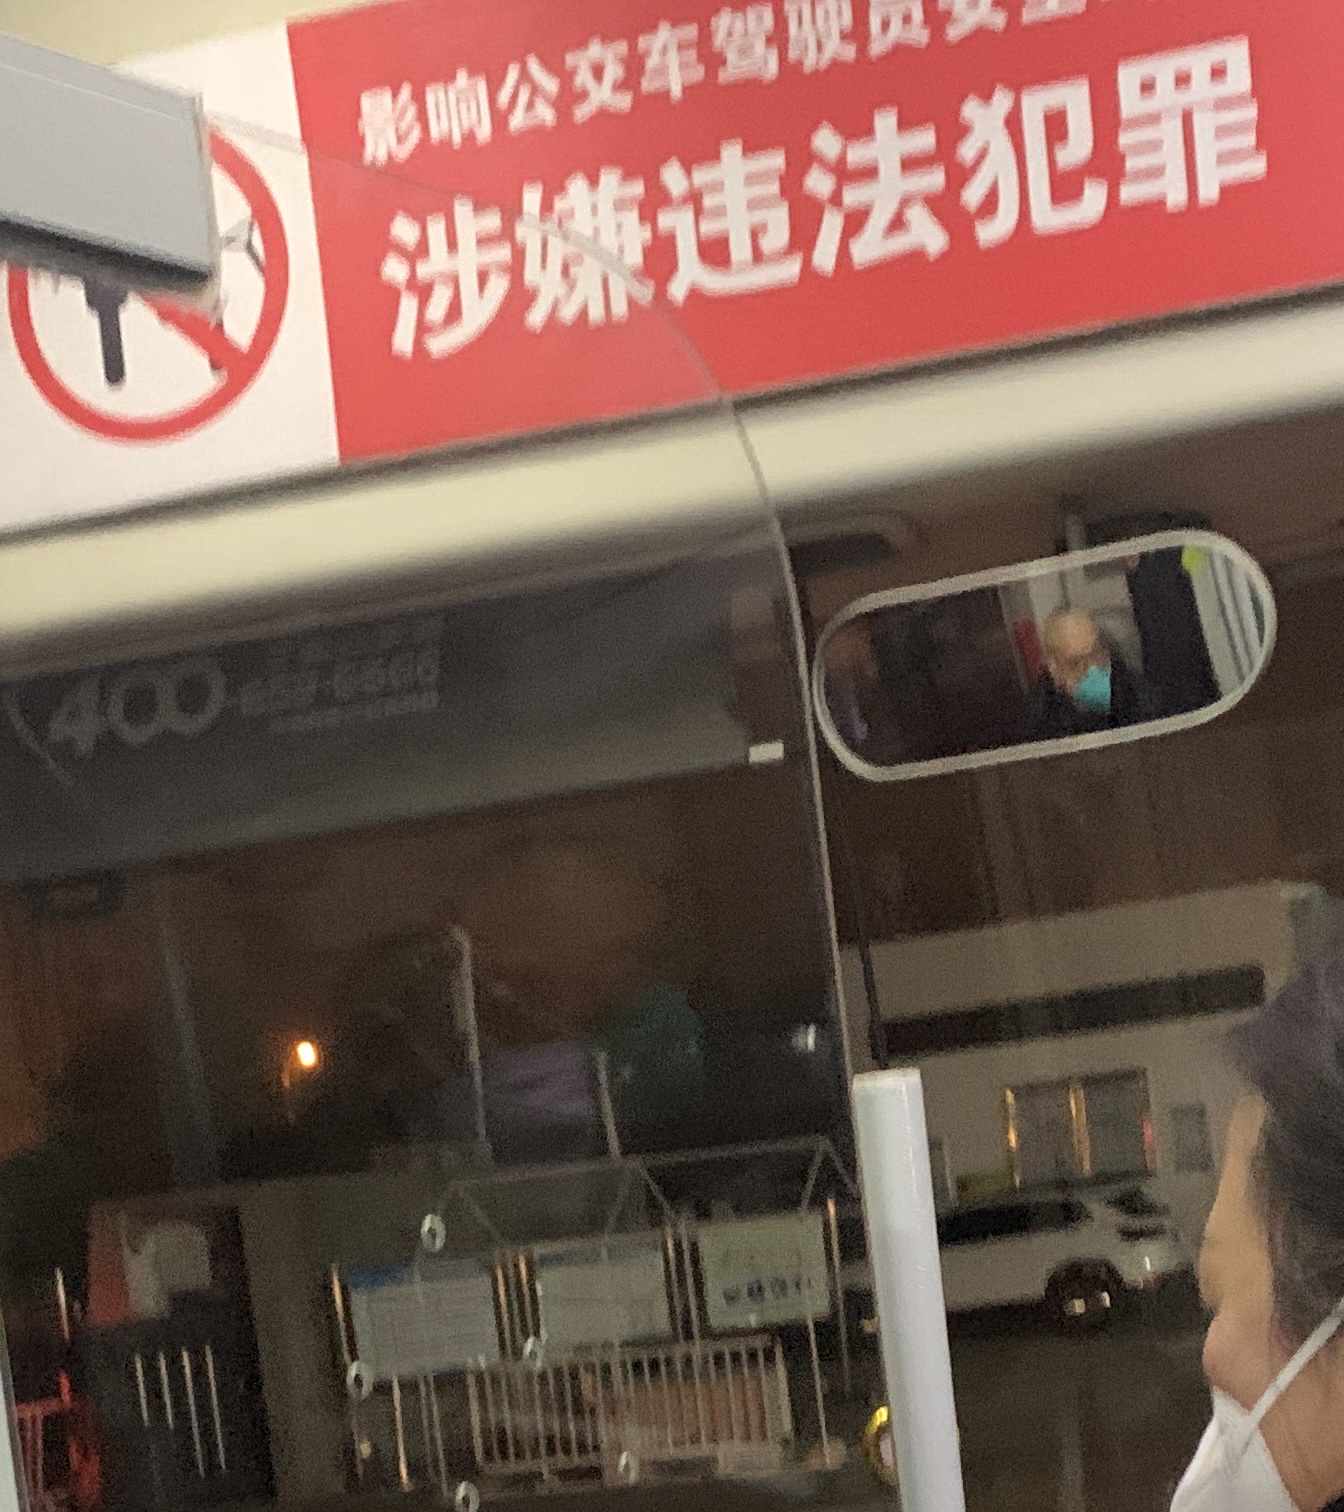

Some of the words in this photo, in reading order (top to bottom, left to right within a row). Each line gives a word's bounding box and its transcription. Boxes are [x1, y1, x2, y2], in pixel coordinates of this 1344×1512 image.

[381, 35, 1268, 362] 涉嫌违法犯罪
